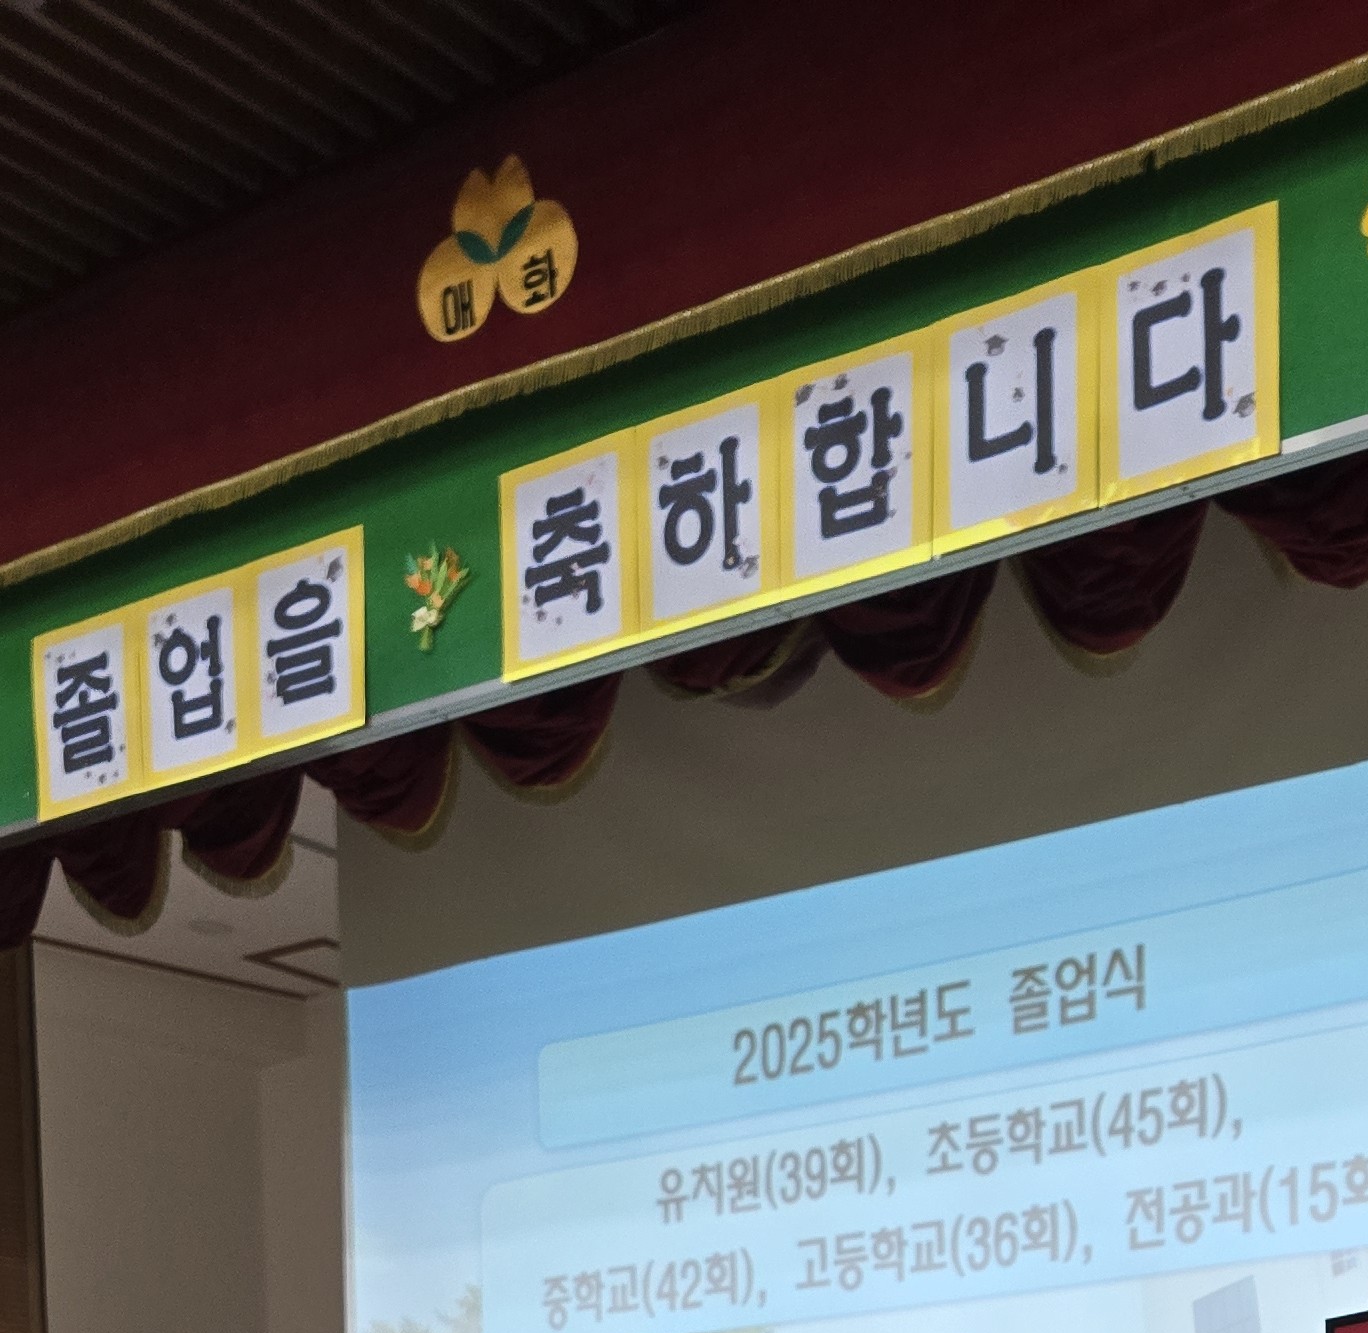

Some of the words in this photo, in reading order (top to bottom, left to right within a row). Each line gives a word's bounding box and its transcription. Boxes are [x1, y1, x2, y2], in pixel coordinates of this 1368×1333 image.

[521, 249, 558, 308] 화
[52, 577, 344, 776] 졸업을
[525, 266, 1241, 615] 축하합니다
[732, 980, 974, 1087] 2025학년도
[1010, 943, 1147, 1036] 졸업식
[655, 1132, 896, 1225] 유치원(39회),
[925, 1073, 1243, 1176] 초등학교(45회),
[541, 1246, 769, 1331] 중학교(42회),
[796, 1200, 1093, 1292] 고등학교(36회),
